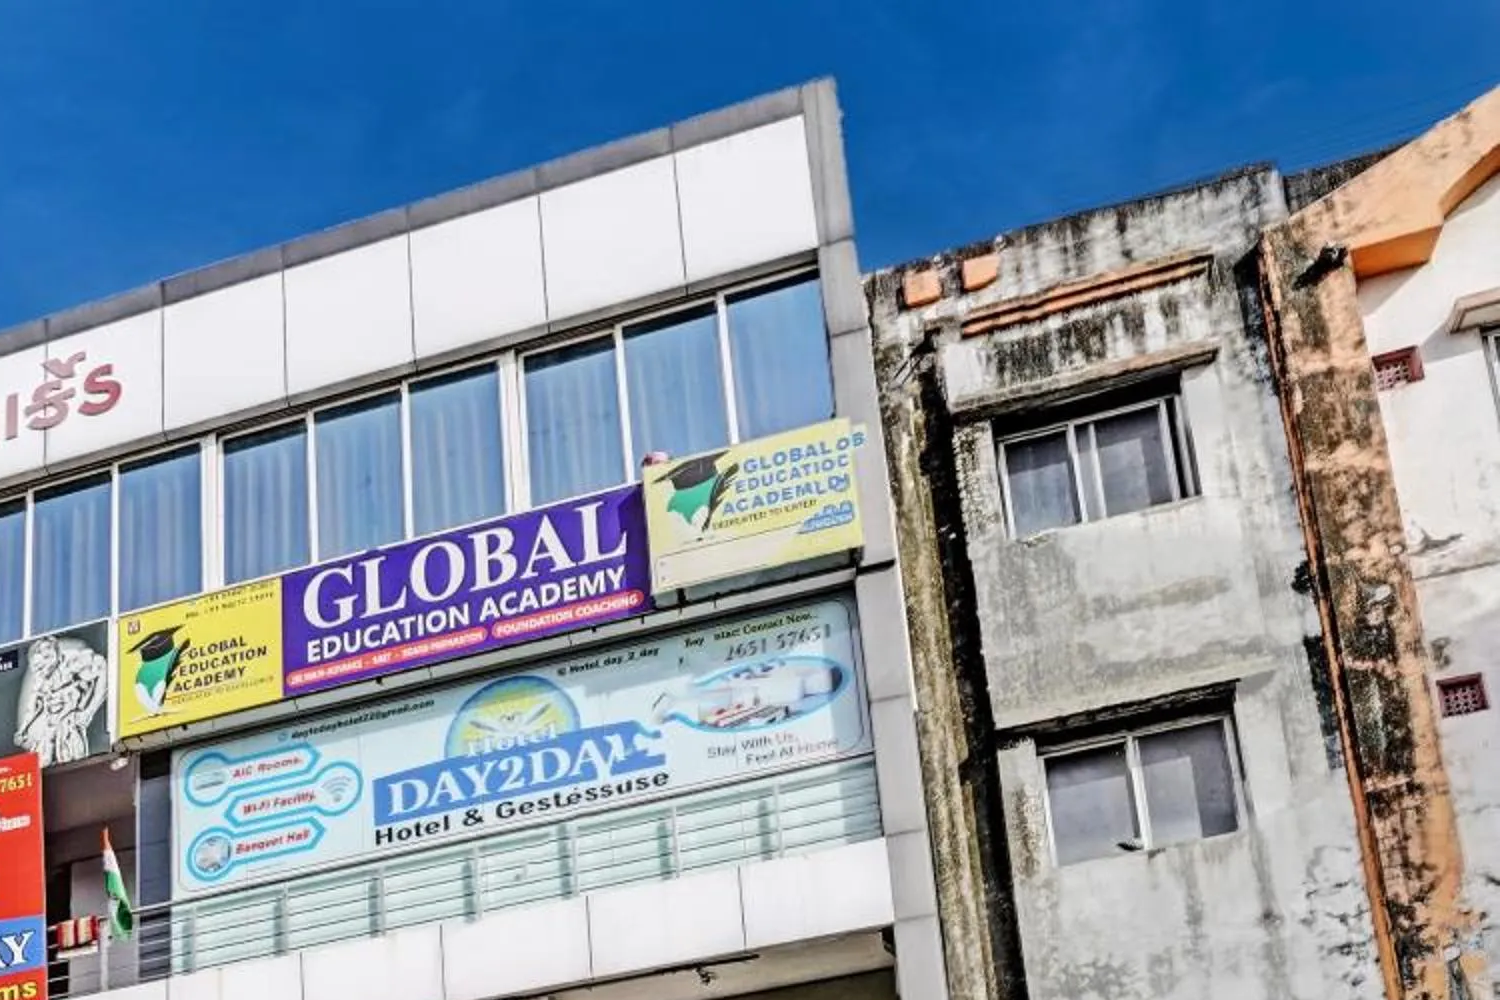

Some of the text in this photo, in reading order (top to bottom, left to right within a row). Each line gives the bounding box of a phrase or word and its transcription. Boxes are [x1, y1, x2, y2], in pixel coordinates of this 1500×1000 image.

[303, 500, 628, 630] GLOBAL
[307, 600, 470, 664] EDUCATION
[480, 565, 627, 622] ACADEMY
[495, 593, 641, 638] FOUNDATION COACHING
[179, 645, 268, 677] EDUCATION
[189, 635, 249, 660] GLOBAL
[173, 666, 247, 692] ACADEMY
[374, 815, 451, 846] Hotel
[463, 802, 484, 827] &
